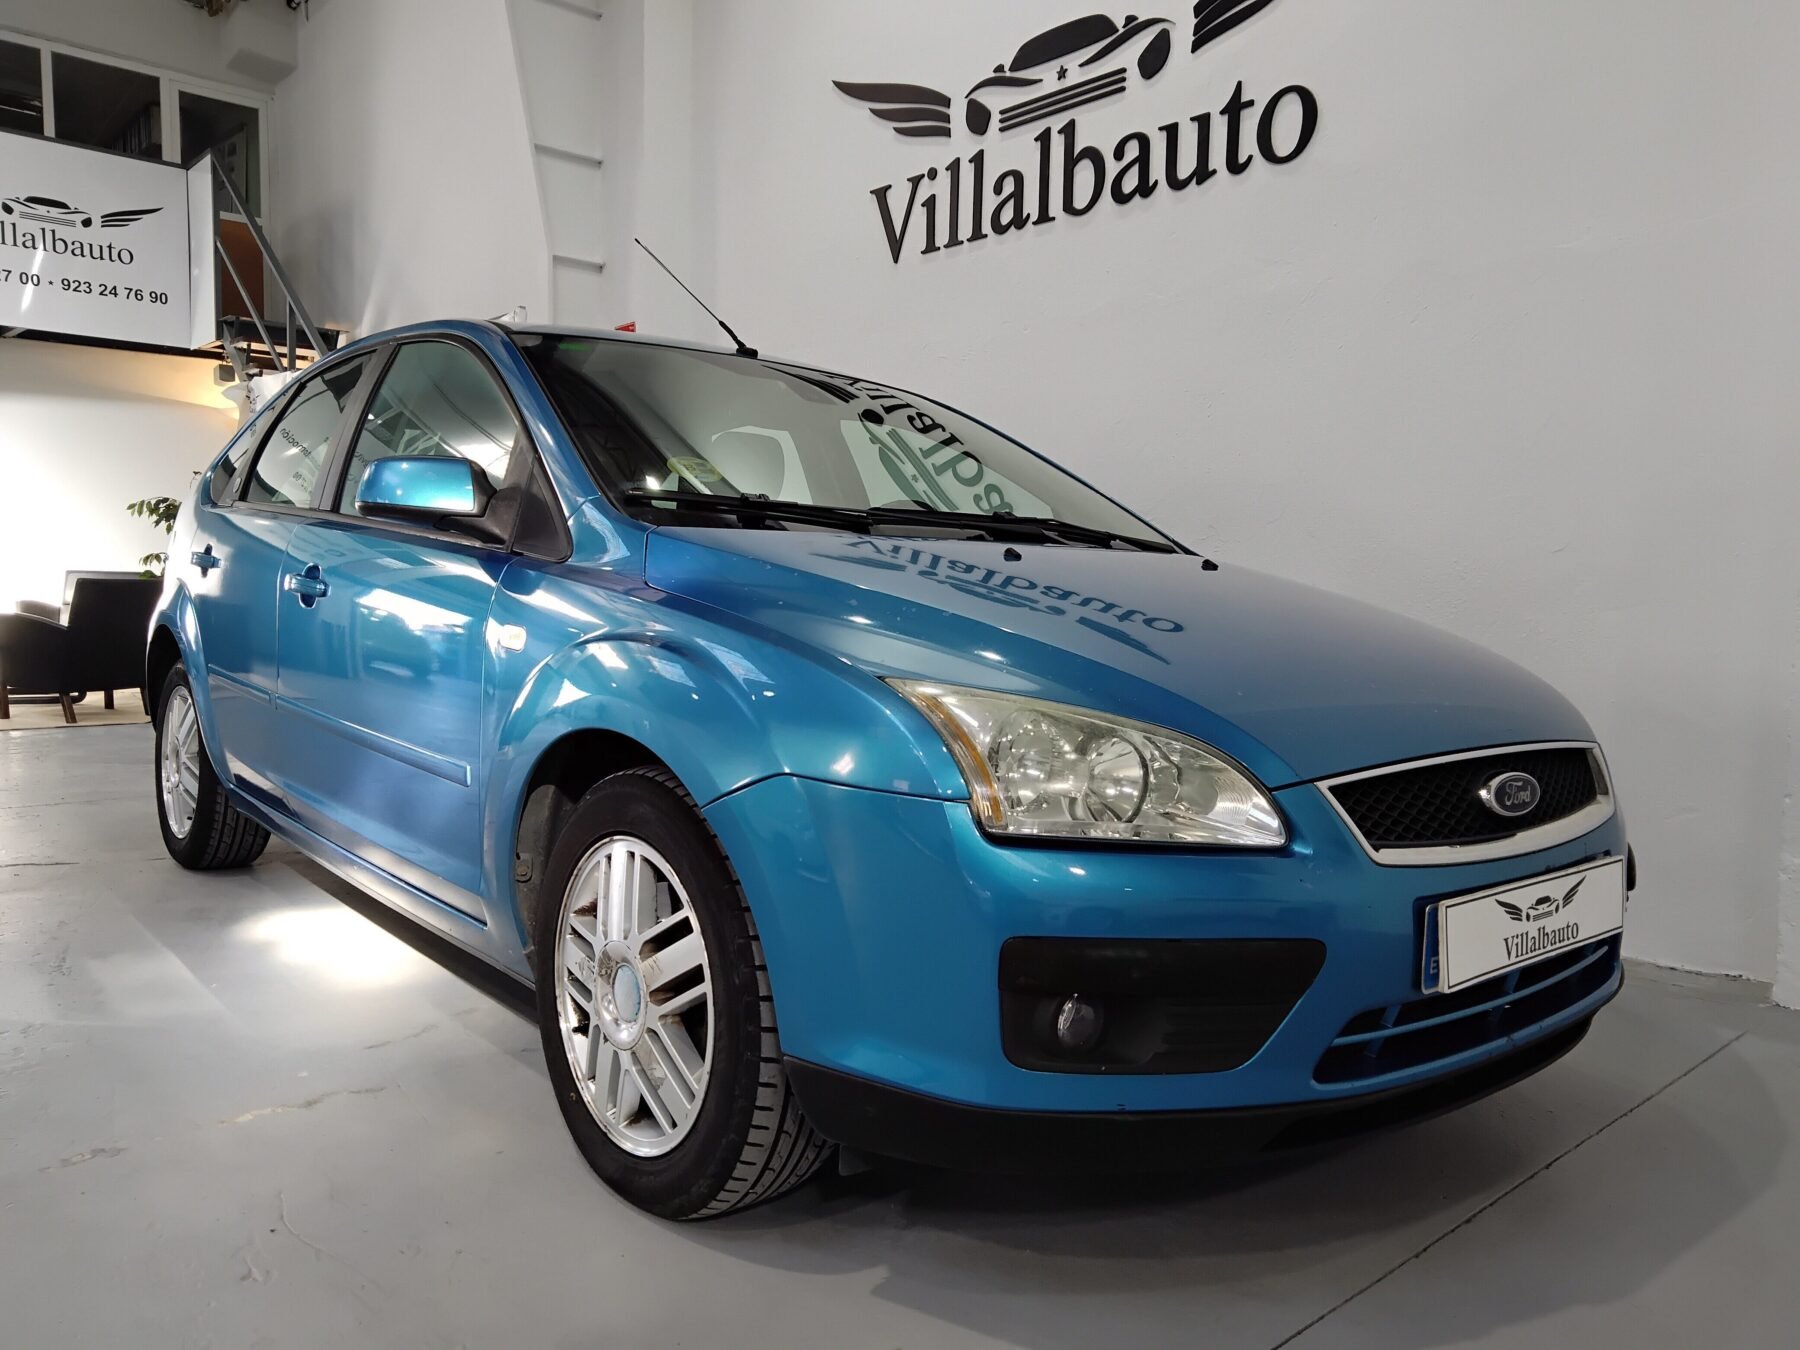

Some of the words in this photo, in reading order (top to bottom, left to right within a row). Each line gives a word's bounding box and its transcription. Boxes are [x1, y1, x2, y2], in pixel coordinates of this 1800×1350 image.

[870, 80, 1318, 264] Villalbauto
[0, 269, 12, 282] 7
[19, 272, 41, 286] 00
[61, 278, 93, 294] 923
[98, 283, 118, 298] 24
[124, 287, 144, 301] 76
[149, 291, 169, 305] 90
[1505, 781, 1531, 806] Ford
[1503, 921, 1579, 960] Villalbauto
